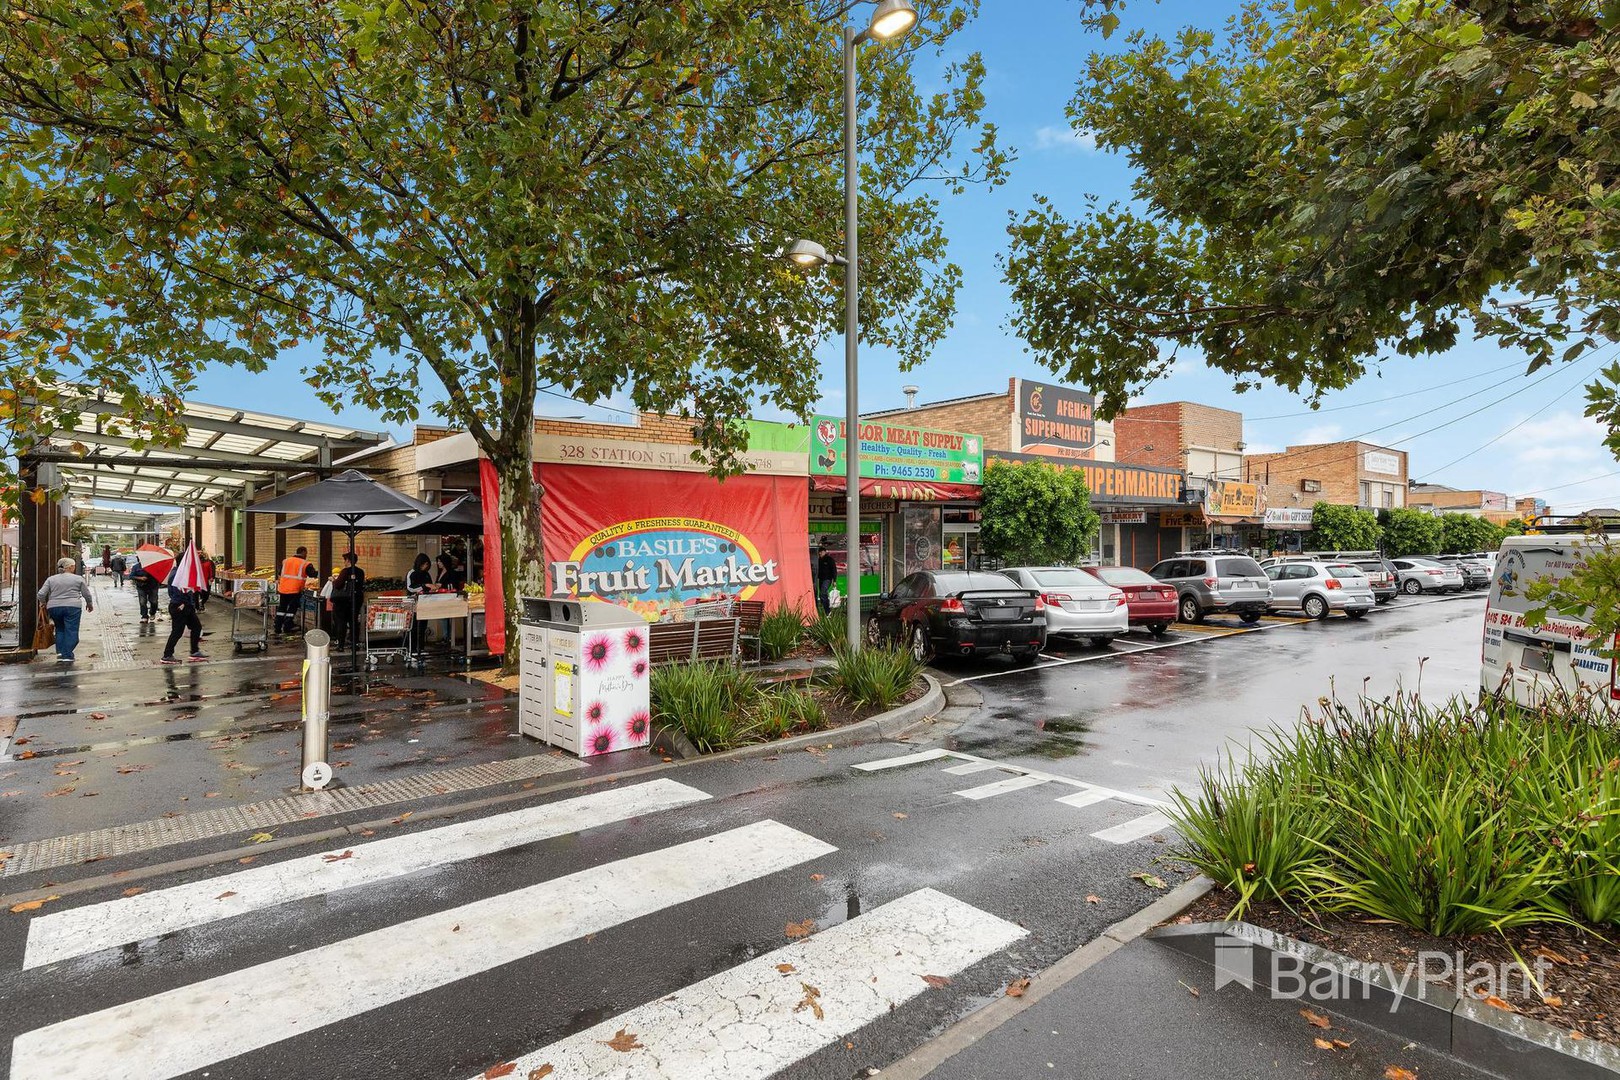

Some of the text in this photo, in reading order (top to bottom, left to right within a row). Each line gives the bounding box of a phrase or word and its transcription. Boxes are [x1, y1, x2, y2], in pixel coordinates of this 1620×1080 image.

[1057, 399, 1092, 420] AFGHAN
[840, 421, 964, 450] LLOR MEAT SUPPLY
[1025, 417, 1092, 443] SUPERMARKET
[560, 444, 585, 459] 328
[591, 447, 654, 464] STATION
[659, 452, 678, 465] ST.
[861, 442, 891, 455] Healthy
[896, 446, 923, 458] Quality
[928, 449, 947, 458] Fresh
[875, 464, 936, 478] Ph: 9465 2530
[859, 501, 893, 511] UTCHER
[1223, 494, 1254, 506] FIVE GUYS
[1111, 512, 1144, 520] BAKERY
[1165, 516, 1183, 526] FIVE
[1291, 511, 1301, 521] GIFT
[1301, 512, 1312, 522] SHOP
[590, 524, 624, 546] QUALITY
[634, 518, 682, 530] FRESHNESS
[683, 519, 735, 538] GUARANTEED
[617, 537, 717, 558] BASILE'S
[1545, 560, 1553, 568] For
[1562, 561, 1574, 569] Your
[552, 553, 780, 595] Fruit Market
[1574, 644, 1588, 655] BEST
[621, 679, 634, 692] Day
